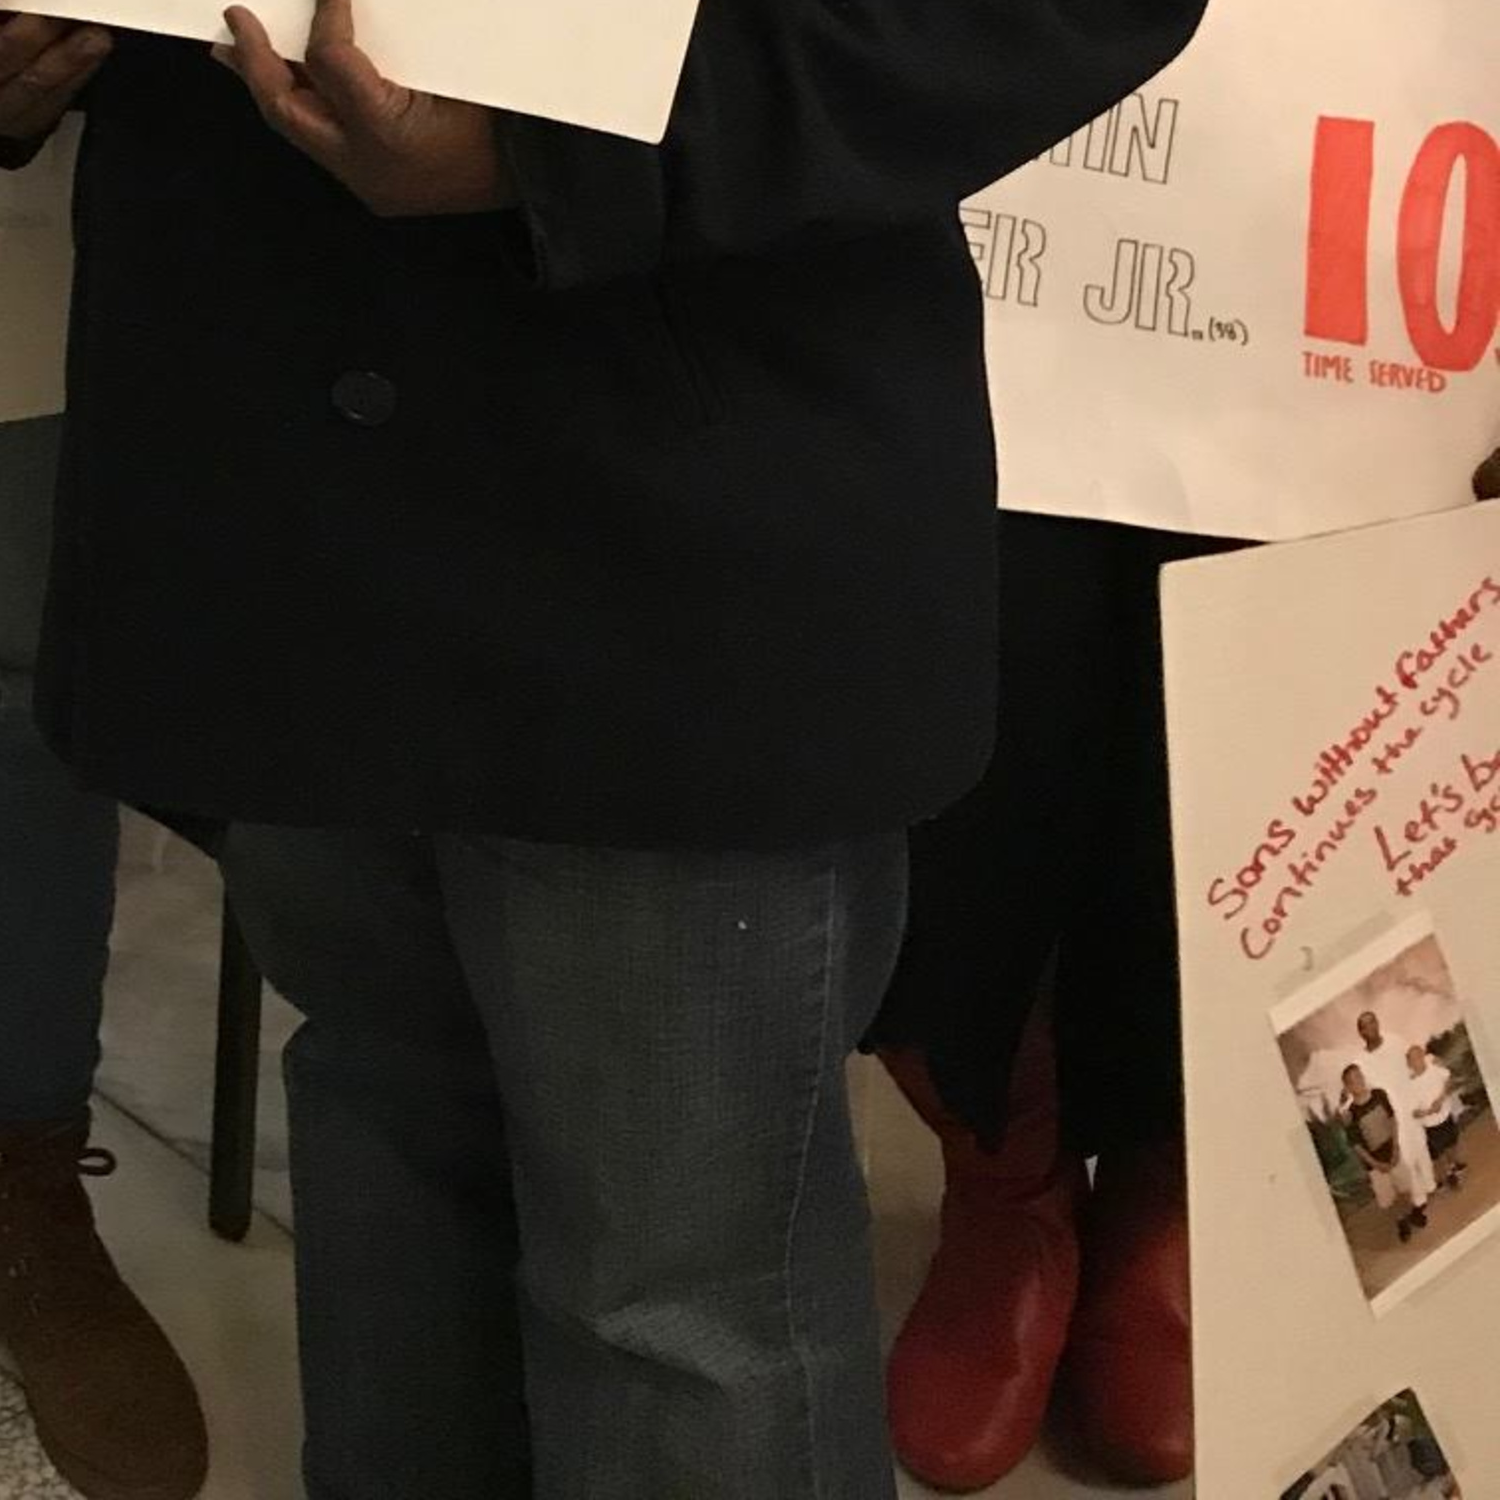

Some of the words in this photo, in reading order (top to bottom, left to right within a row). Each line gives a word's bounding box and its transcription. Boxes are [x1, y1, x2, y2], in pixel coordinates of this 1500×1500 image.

[1301, 350, 1354, 385] TIME
[1368, 358, 1446, 393] SERVED
[1371, 726, 1423, 775] the
[1419, 642, 1494, 721] cycle
[1207, 818, 1296, 921] Sons
[1291, 686, 1399, 818] without
